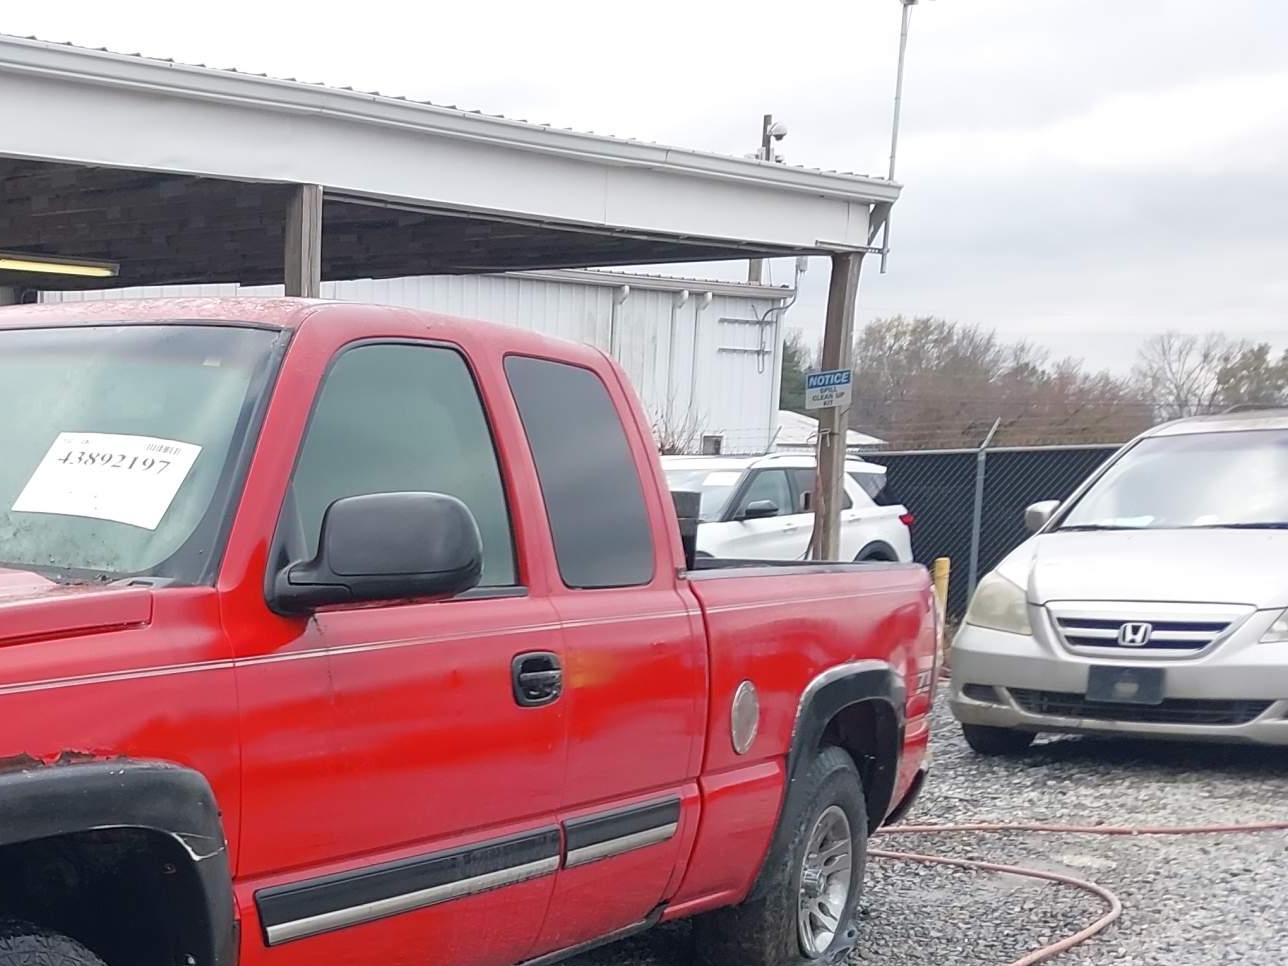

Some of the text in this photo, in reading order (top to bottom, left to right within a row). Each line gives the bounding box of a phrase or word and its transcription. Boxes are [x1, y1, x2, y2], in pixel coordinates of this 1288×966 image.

[808, 372, 849, 387] NOTICE
[812, 391, 845, 401] CLEAN UP
[58, 451, 171, 474] 43892197
